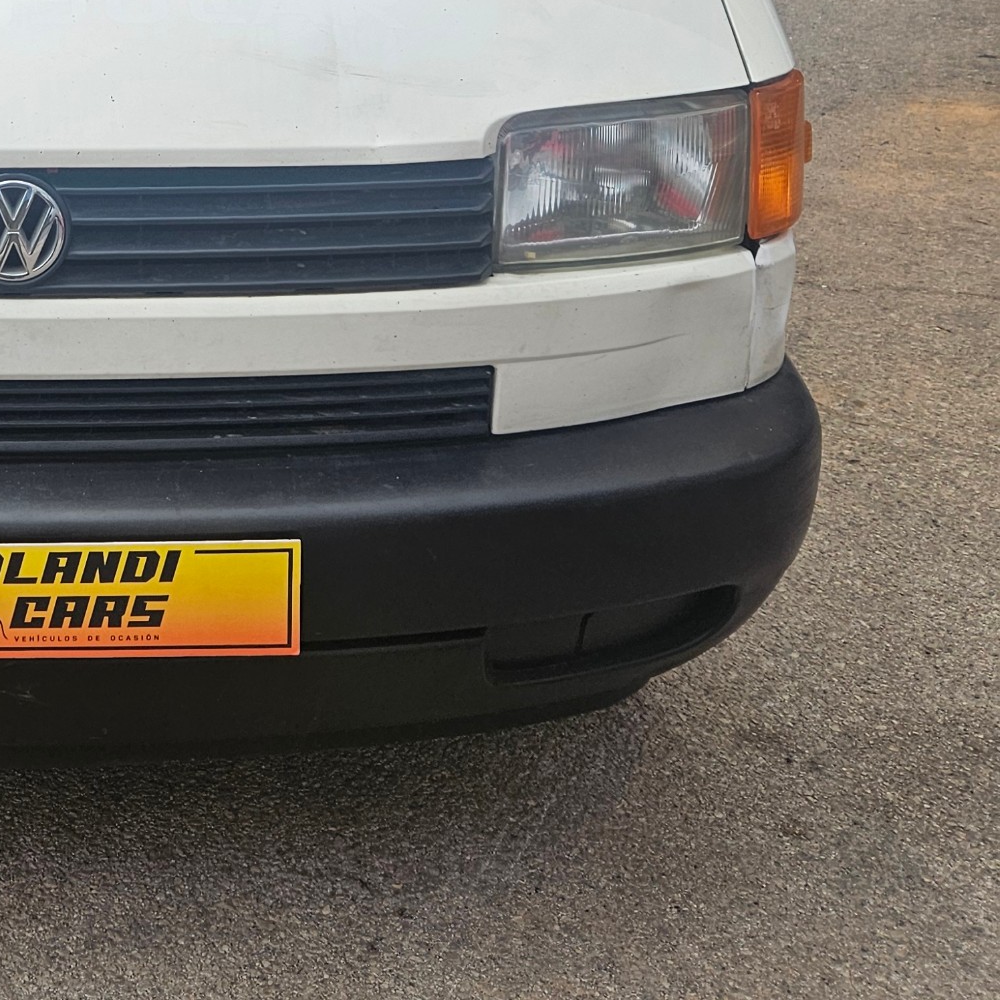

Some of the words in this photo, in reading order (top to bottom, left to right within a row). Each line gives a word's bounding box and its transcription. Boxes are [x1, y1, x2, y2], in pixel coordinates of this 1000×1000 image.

[9, 594, 170, 629] CARS
[14, 634, 78, 642] VEHÍCULOS
[110, 633, 160, 641] OCASIÓN
